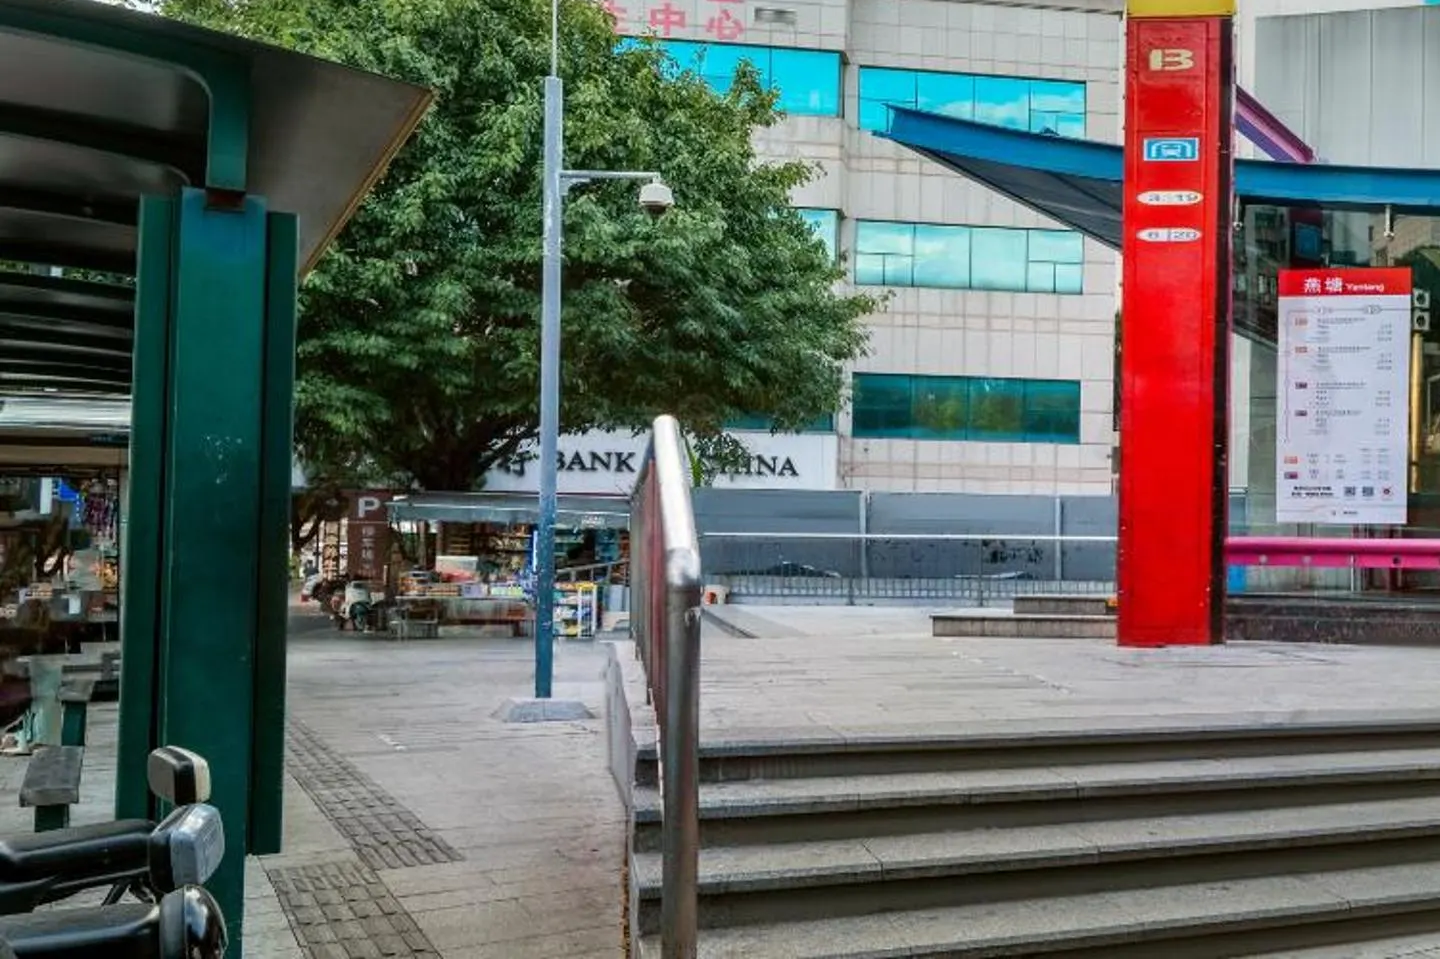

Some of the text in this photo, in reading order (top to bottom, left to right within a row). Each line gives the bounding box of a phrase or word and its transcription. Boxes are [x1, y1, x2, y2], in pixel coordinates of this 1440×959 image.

[1149, 48, 1194, 72] B
[1304, 277, 1343, 293] 燕塘
[358, 496, 381, 518] P
